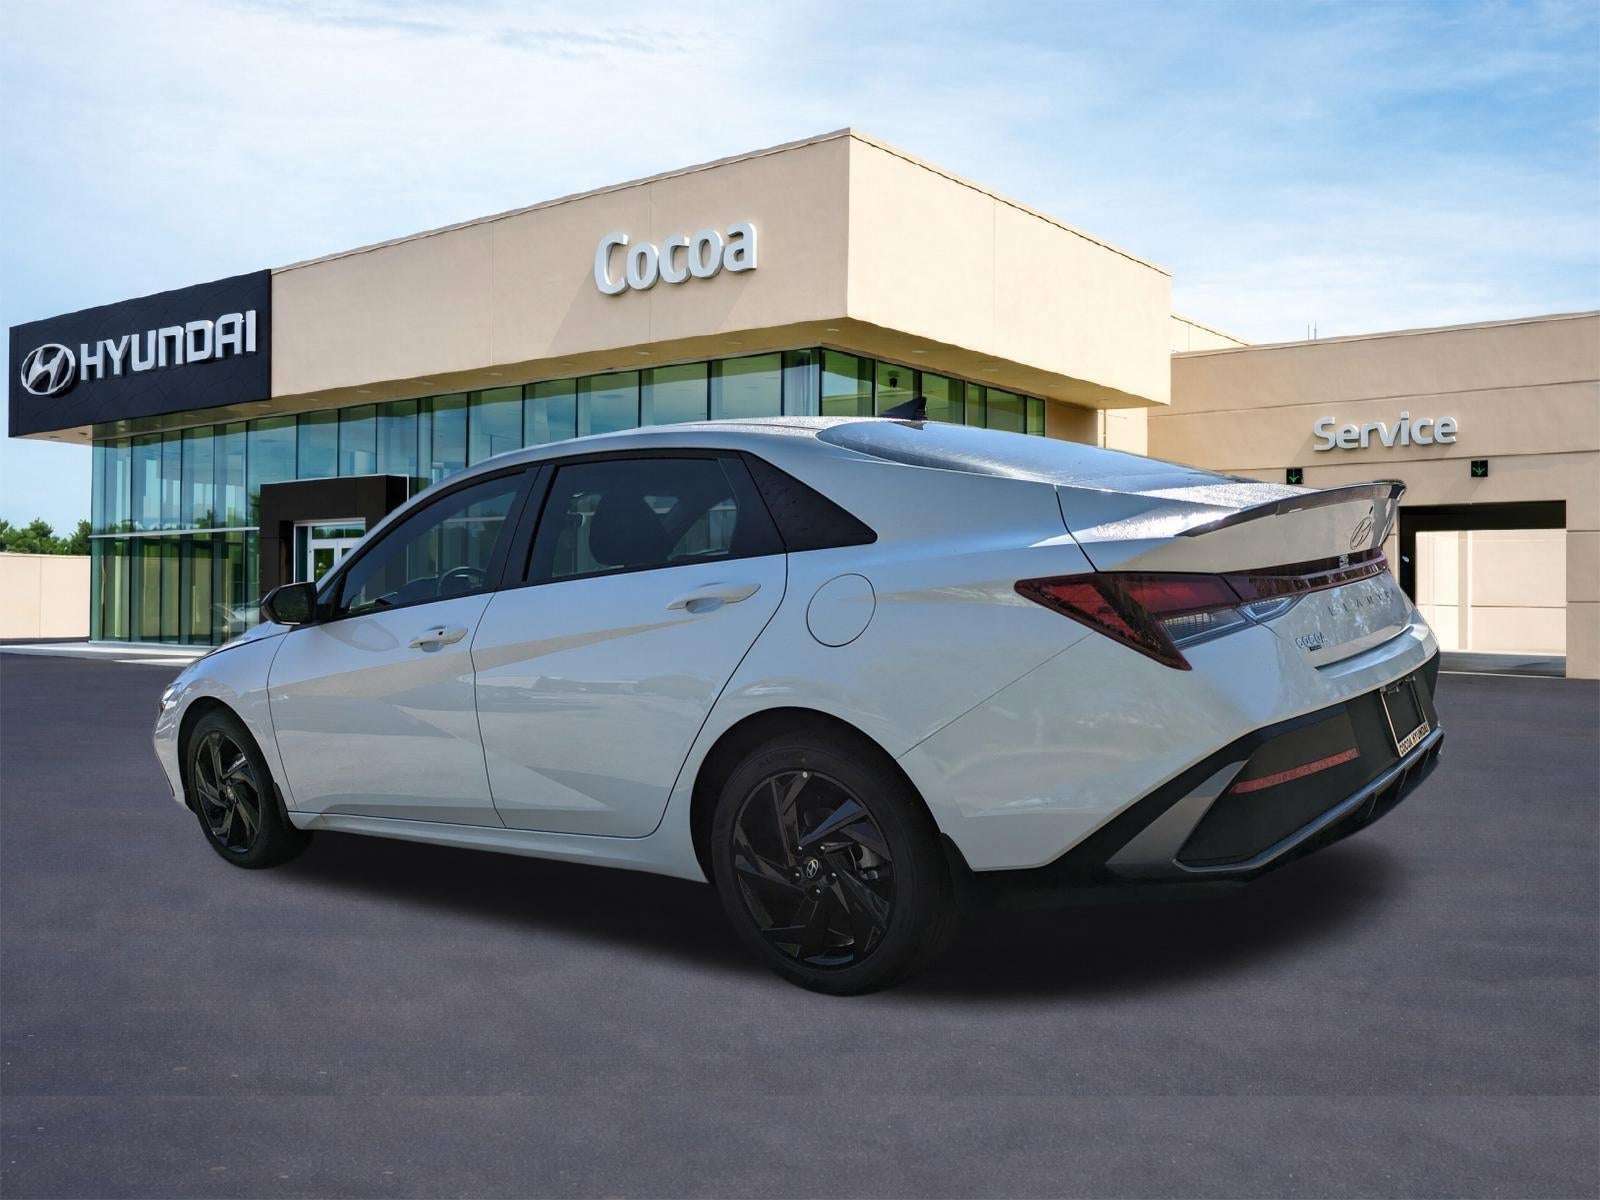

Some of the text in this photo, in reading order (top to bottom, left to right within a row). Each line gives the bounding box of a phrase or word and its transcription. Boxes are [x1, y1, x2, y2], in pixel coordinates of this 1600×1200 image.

[594, 222, 757, 295] Cocoa
[80, 309, 256, 381] HYUNDAI
[1313, 410, 1458, 451] Service
